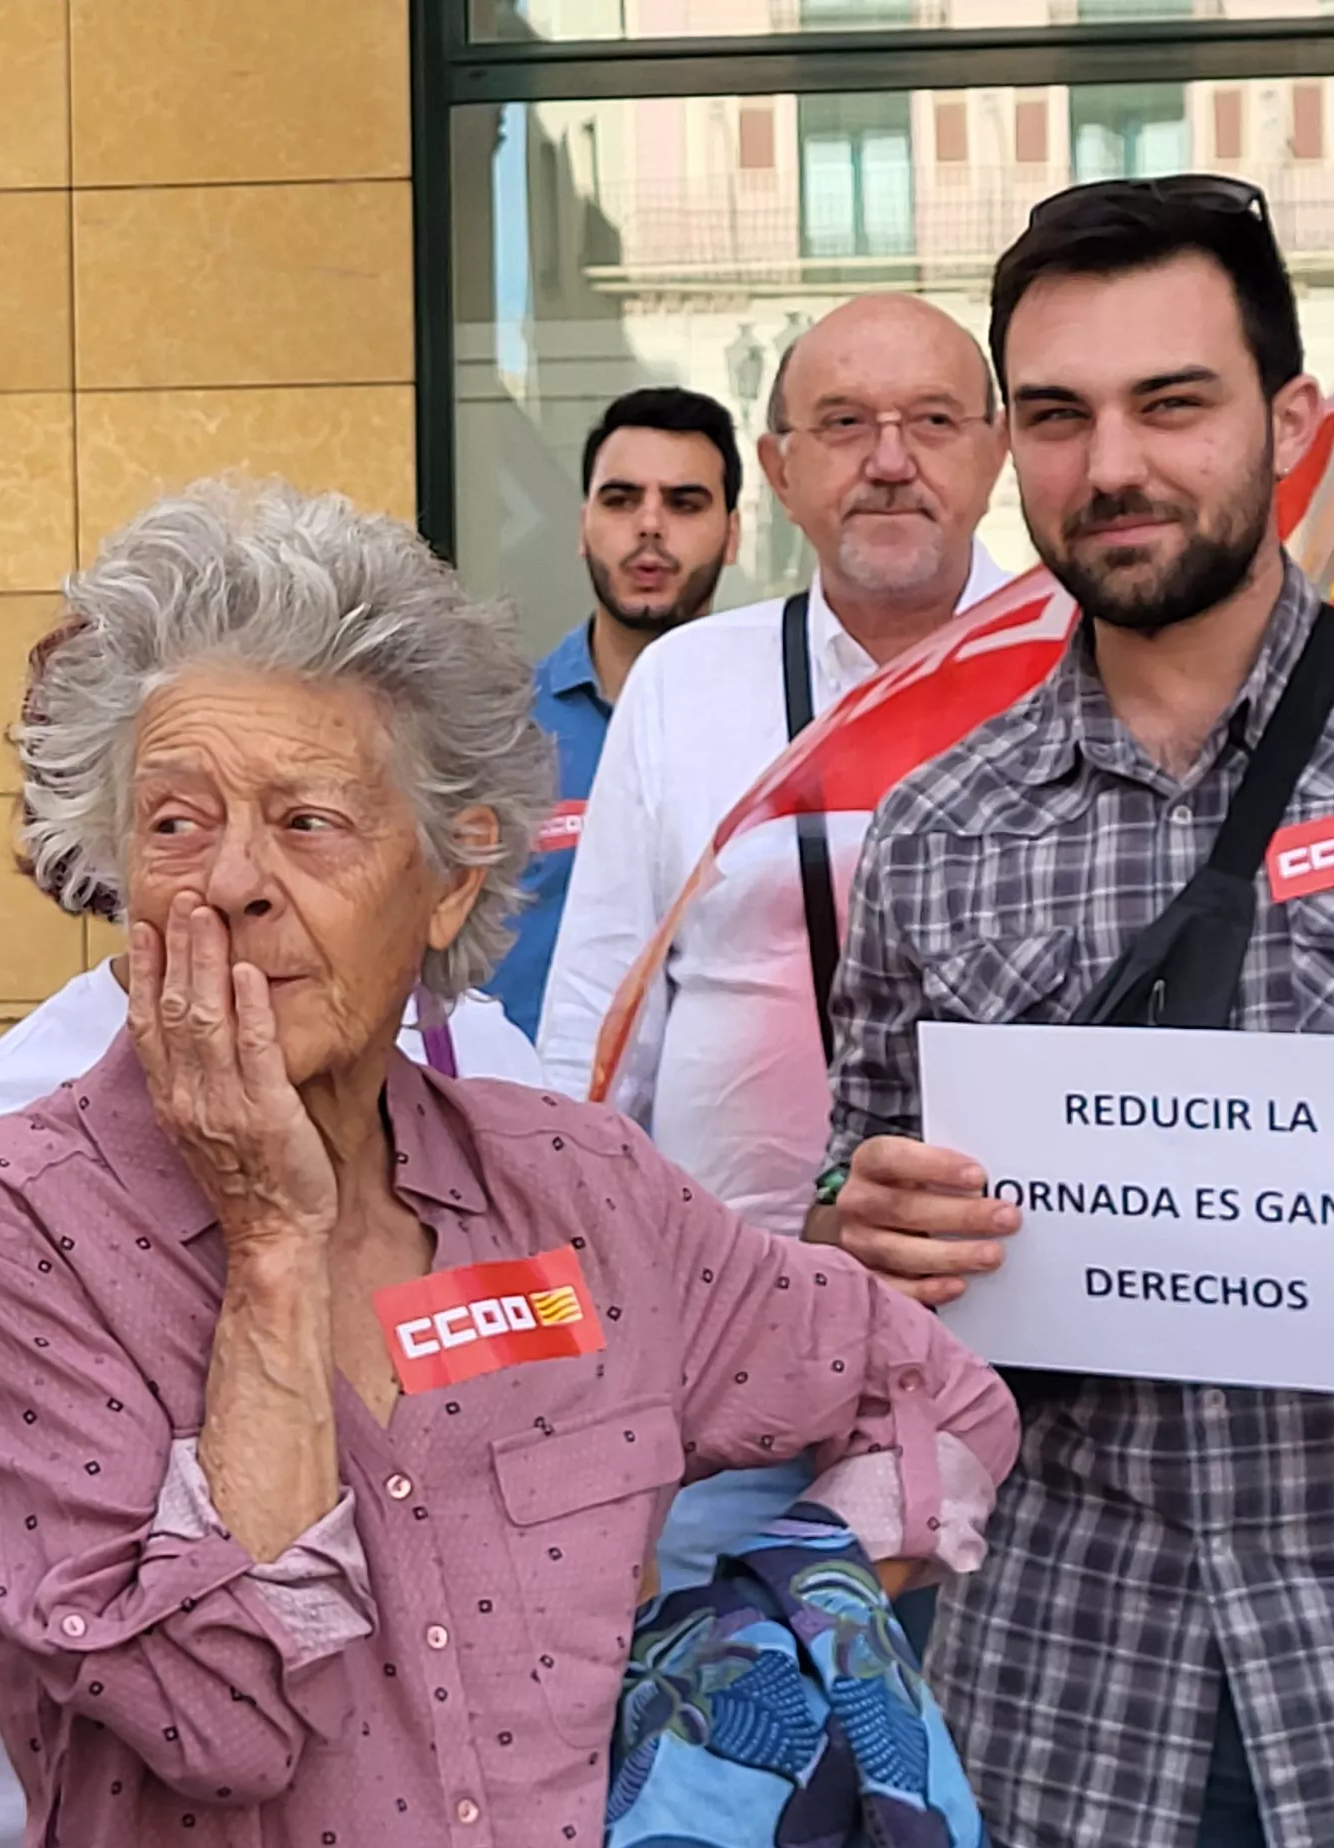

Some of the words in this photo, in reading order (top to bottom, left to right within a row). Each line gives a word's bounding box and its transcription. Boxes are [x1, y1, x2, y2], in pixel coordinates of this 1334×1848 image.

[1065, 1094, 1252, 1131] REDUCIR
[1269, 1099, 1318, 1132] LA
[1196, 1188, 1240, 1221] ES
[1085, 1267, 1309, 1310] DERECHOS
[396, 1296, 537, 1359] CCOO
